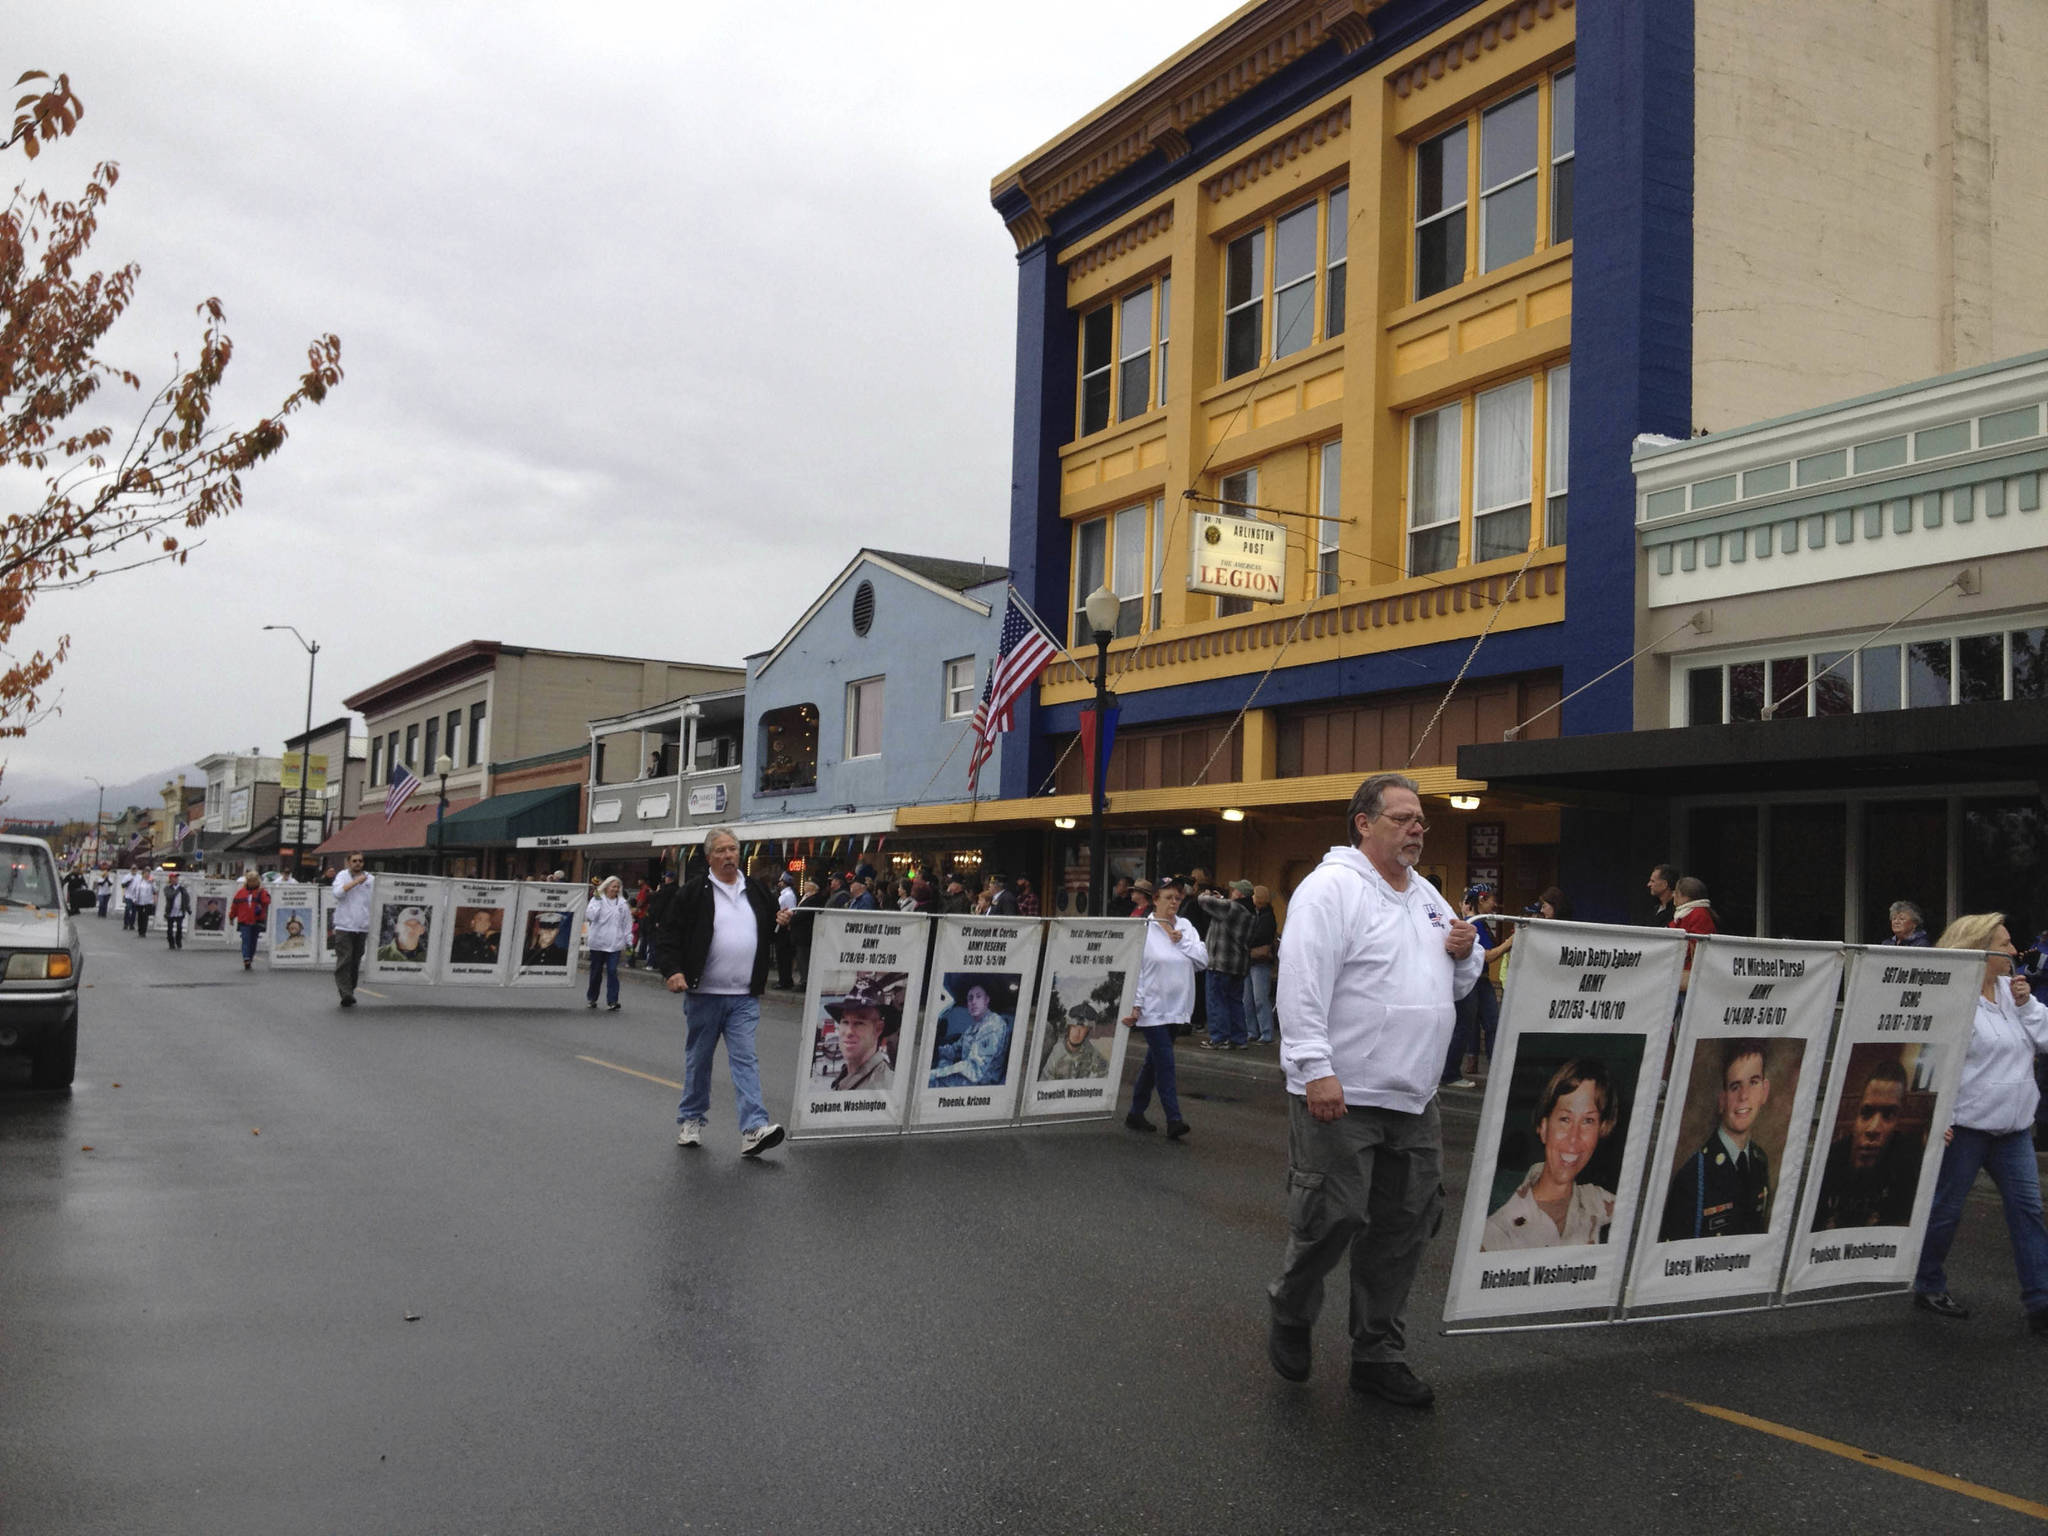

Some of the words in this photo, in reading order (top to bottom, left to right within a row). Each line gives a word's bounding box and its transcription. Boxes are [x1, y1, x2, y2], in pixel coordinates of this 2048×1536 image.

[1234, 525, 1274, 541] ARLINGTON
[1243, 542, 1264, 555] POST
[1221, 559, 1232, 567] THE
[1234, 561, 1262, 571] AMERICAN
[1200, 564, 1281, 594] LEGION
[884, 924, 901, 936] Lyons
[862, 938, 880, 949] ARMY
[967, 940, 984, 951] ARMY
[983, 941, 1007, 952] RESERVE
[1559, 946, 1586, 968] Major
[1587, 947, 1612, 969] Betty
[1733, 957, 1746, 976] CPL
[1747, 957, 1778, 976] Michael
[1779, 959, 1805, 977] Pursel
[1882, 966, 1899, 983] SGT
[1895, 967, 1909, 984] Joe
[1579, 974, 1606, 992] ARMY
[1748, 984, 1775, 1000] ARMY
[1900, 991, 1922, 1008] USMC
[1549, 999, 1584, 1019] 8/27/53
[1590, 1000, 1626, 1020] 4/18/10
[1757, 1007, 1787, 1025] 5/6/07
[967, 1095, 991, 1106] Arizona
[1067, 1087, 1103, 1098] Washington
[810, 1102, 842, 1115] Spokane,
[843, 1100, 886, 1112] Washington
[1843, 1242, 1897, 1260] Washington
[1664, 1258, 1692, 1277] Lacey,
[1694, 1253, 1751, 1273] Washington
[1480, 1267, 1530, 1289] Richland,
[1533, 1264, 1597, 1285] Washington
